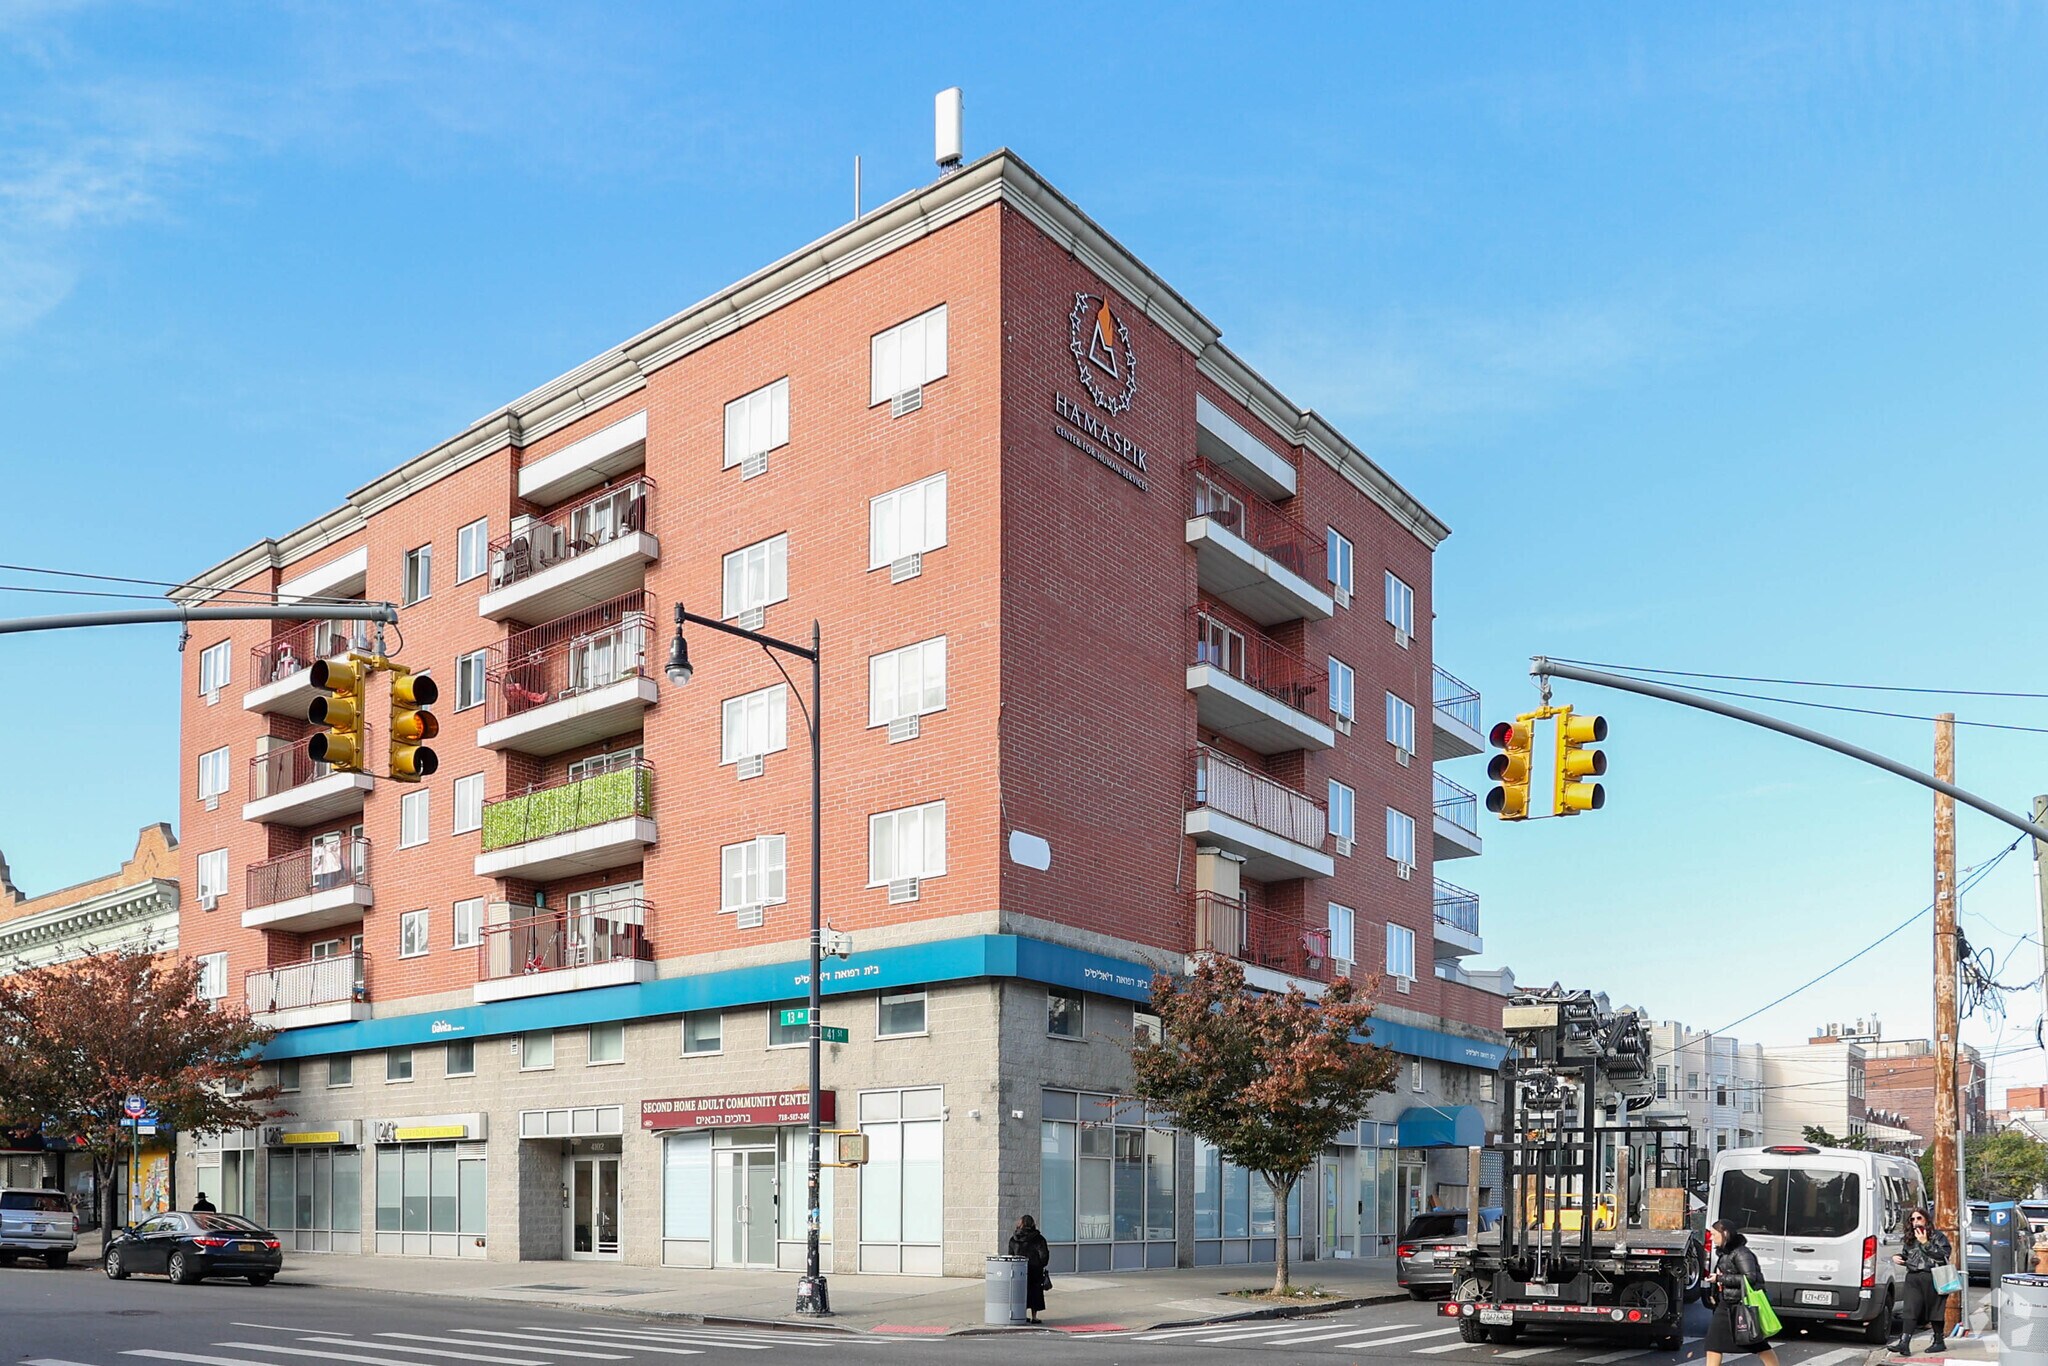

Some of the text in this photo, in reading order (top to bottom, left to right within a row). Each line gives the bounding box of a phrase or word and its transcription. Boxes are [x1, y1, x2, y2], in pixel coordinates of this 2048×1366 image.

[1055, 391, 1147, 472] HAMASPIK
[1055, 425, 1149, 492] CENTER FOR HUMAN SERVICES
[834, 968, 860, 980] רפואה
[863, 965, 880, 976] בית
[1116, 975, 1135, 986] רפואה
[1137, 979, 1149, 989] בית
[787, 1011, 796, 1024] 13
[826, 1028, 836, 1040] 41
[643, 1101, 673, 1114] SECOND
[673, 1100, 696, 1112] HOME
[697, 1098, 725, 1111] ADULT
[725, 1095, 777, 1109] COMMUNITY
[695, 1113, 751, 1125] ברוכים הבאים
[1996, 1212, 2006, 1224] P
